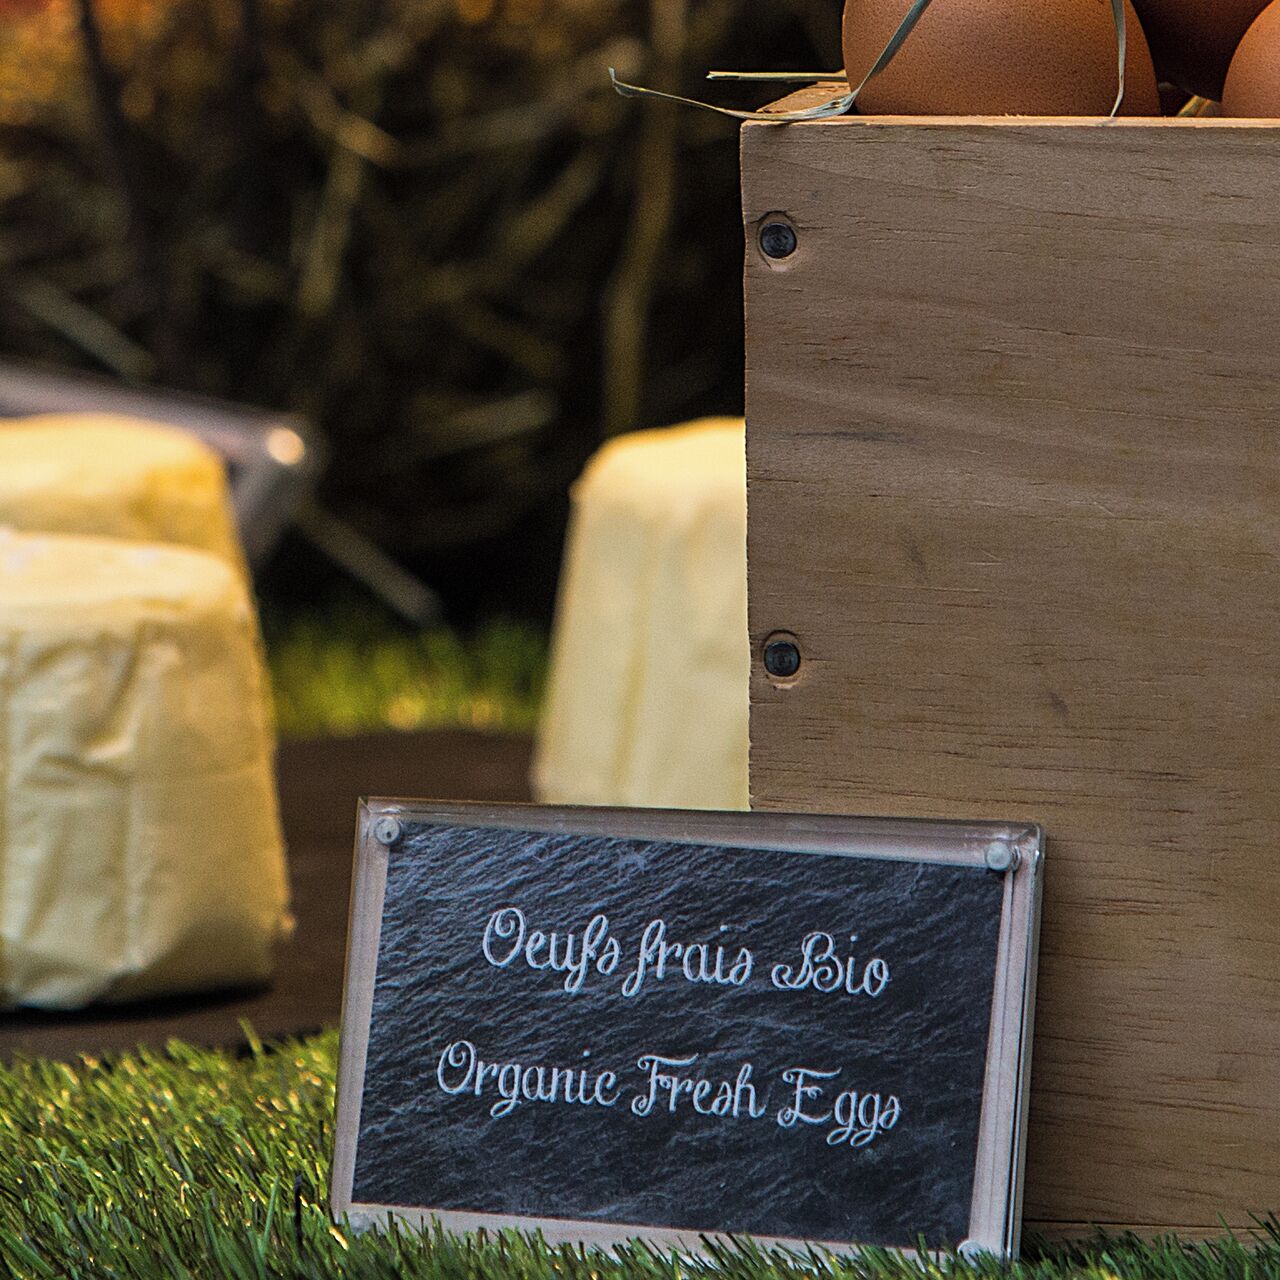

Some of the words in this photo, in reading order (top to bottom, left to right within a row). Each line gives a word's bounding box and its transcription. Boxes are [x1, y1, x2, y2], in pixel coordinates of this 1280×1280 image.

[481, 907, 620, 993] Oeufs
[622, 918, 754, 997] frais
[770, 930, 891, 998] Bio
[436, 1040, 620, 1119] Organic
[630, 1052, 766, 1118] Fresh
[776, 1067, 901, 1146] Eggs
